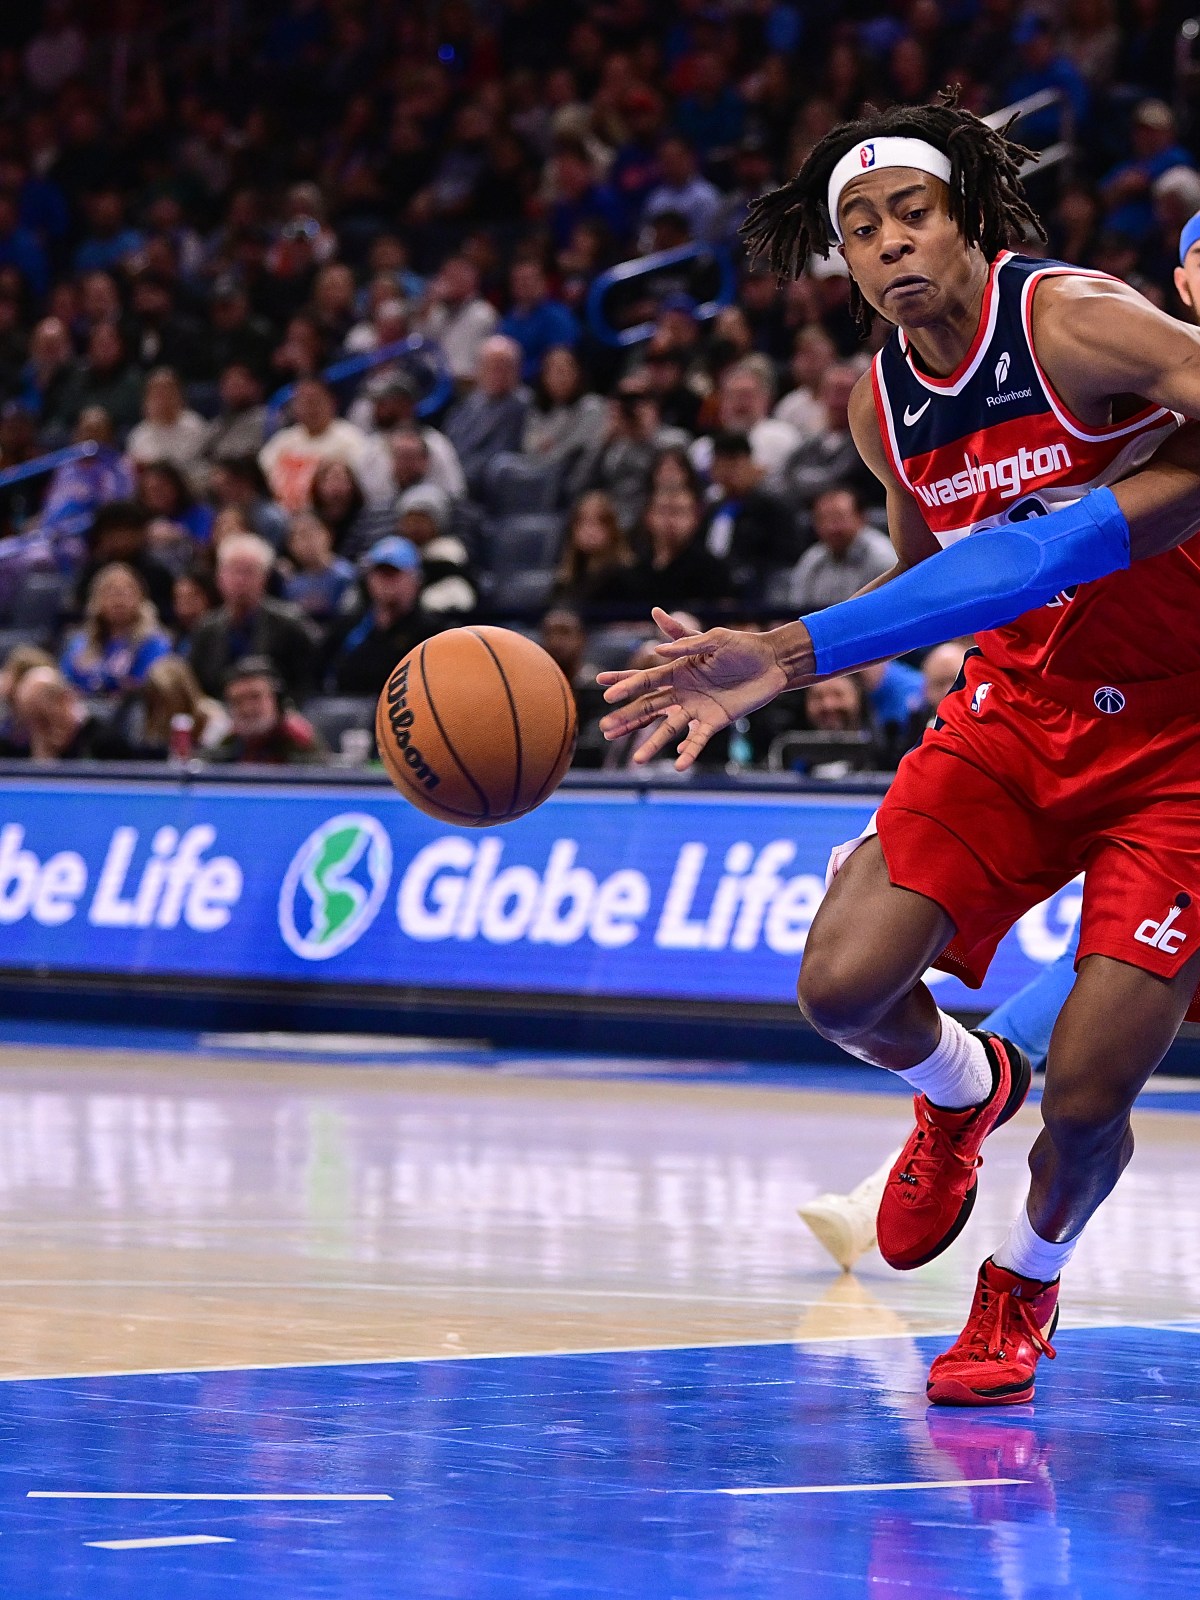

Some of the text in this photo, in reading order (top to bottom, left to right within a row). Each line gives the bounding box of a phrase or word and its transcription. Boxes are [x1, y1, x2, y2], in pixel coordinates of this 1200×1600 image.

[986, 386, 1032, 407] Robinhood
[915, 443, 1072, 507] washington
[387, 660, 440, 791] Wilson
[88, 823, 244, 933] Life
[398, 835, 828, 954] Globe Life
[1134, 905, 1187, 955] dc
